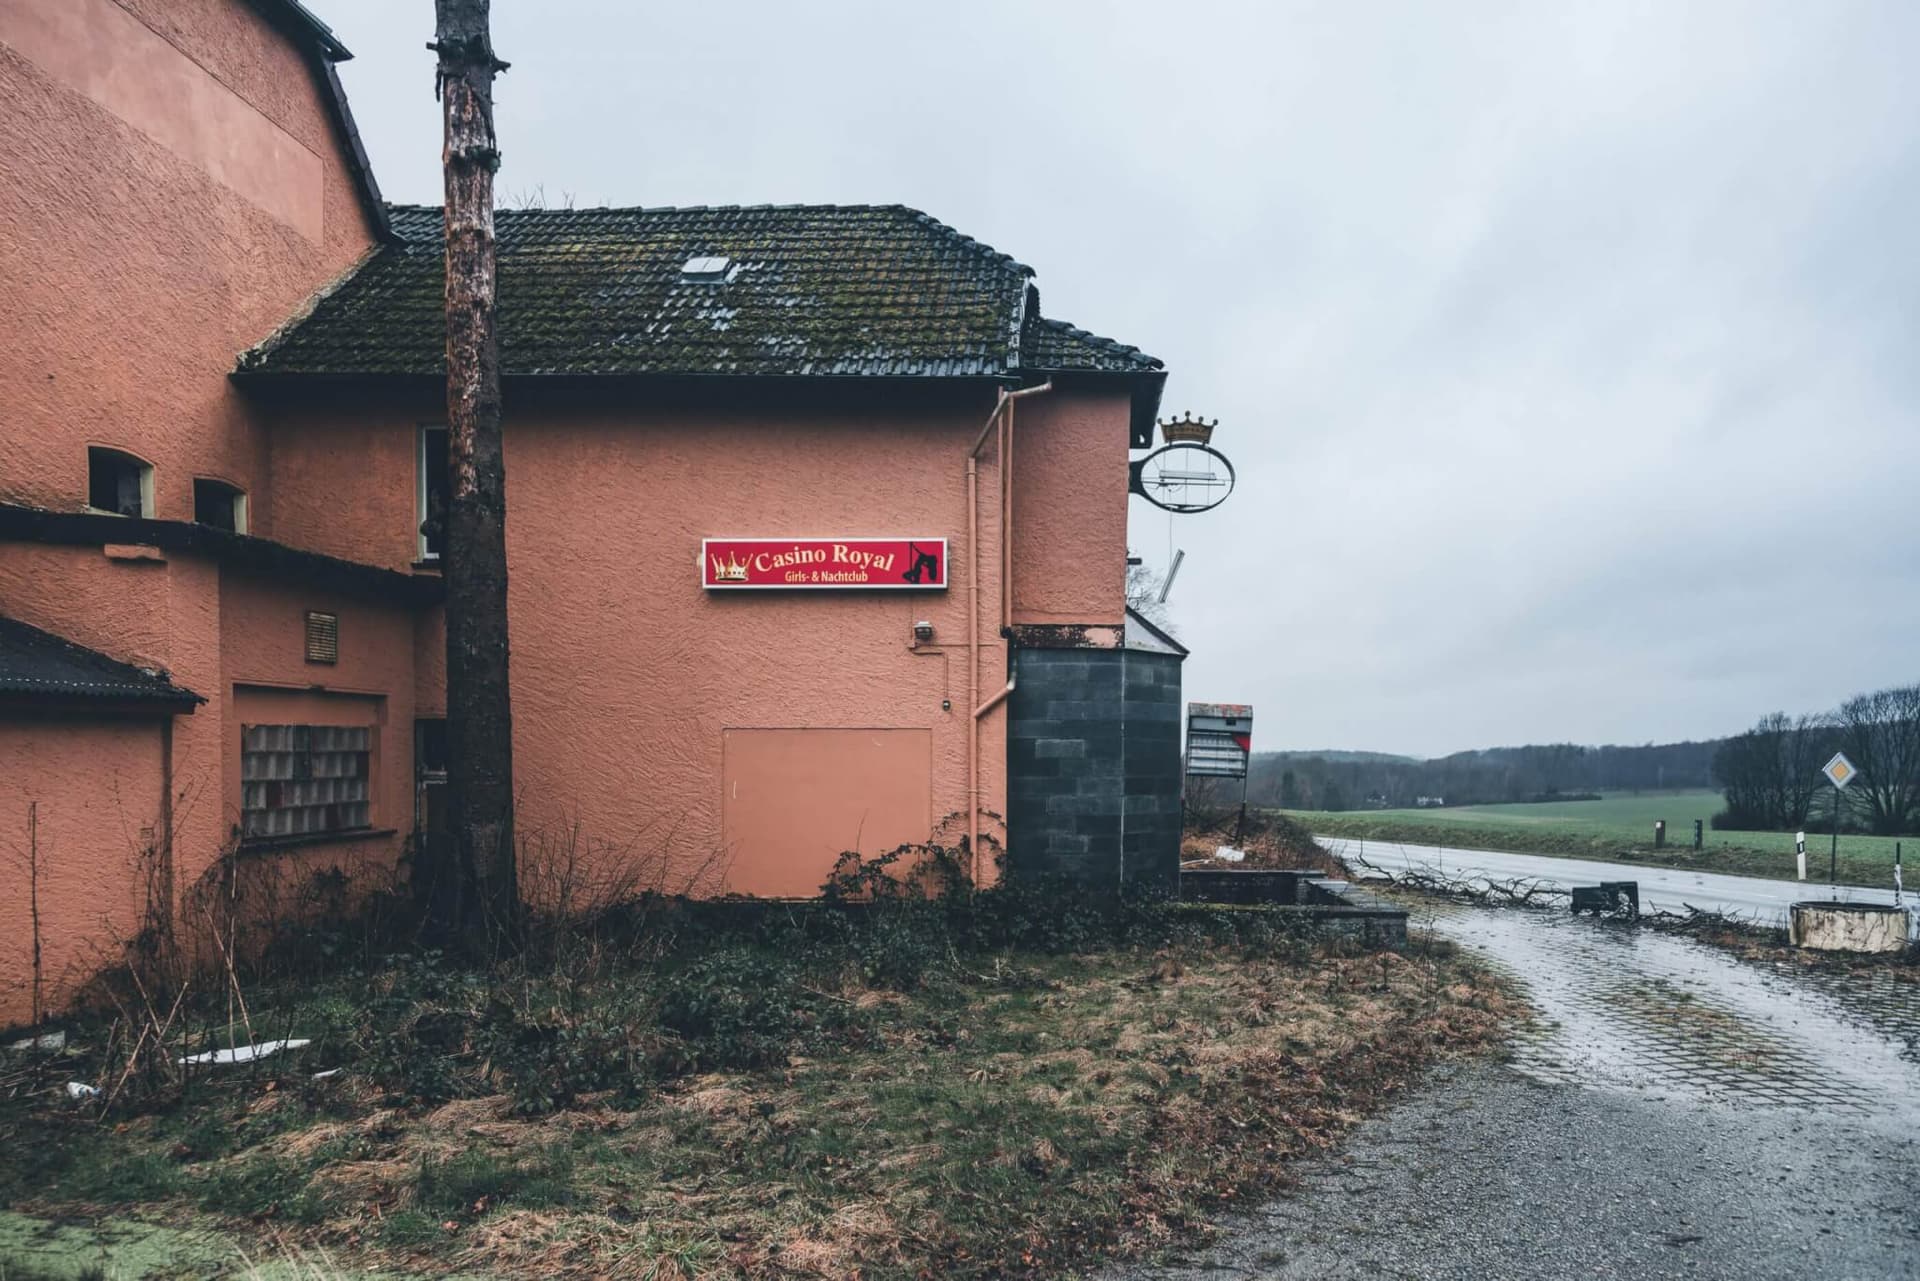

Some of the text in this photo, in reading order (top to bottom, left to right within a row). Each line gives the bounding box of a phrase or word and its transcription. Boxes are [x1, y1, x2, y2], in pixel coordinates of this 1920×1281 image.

[755, 544, 895, 572] Casino Royal
[785, 571, 868, 582] Girls- & Nachtclub
